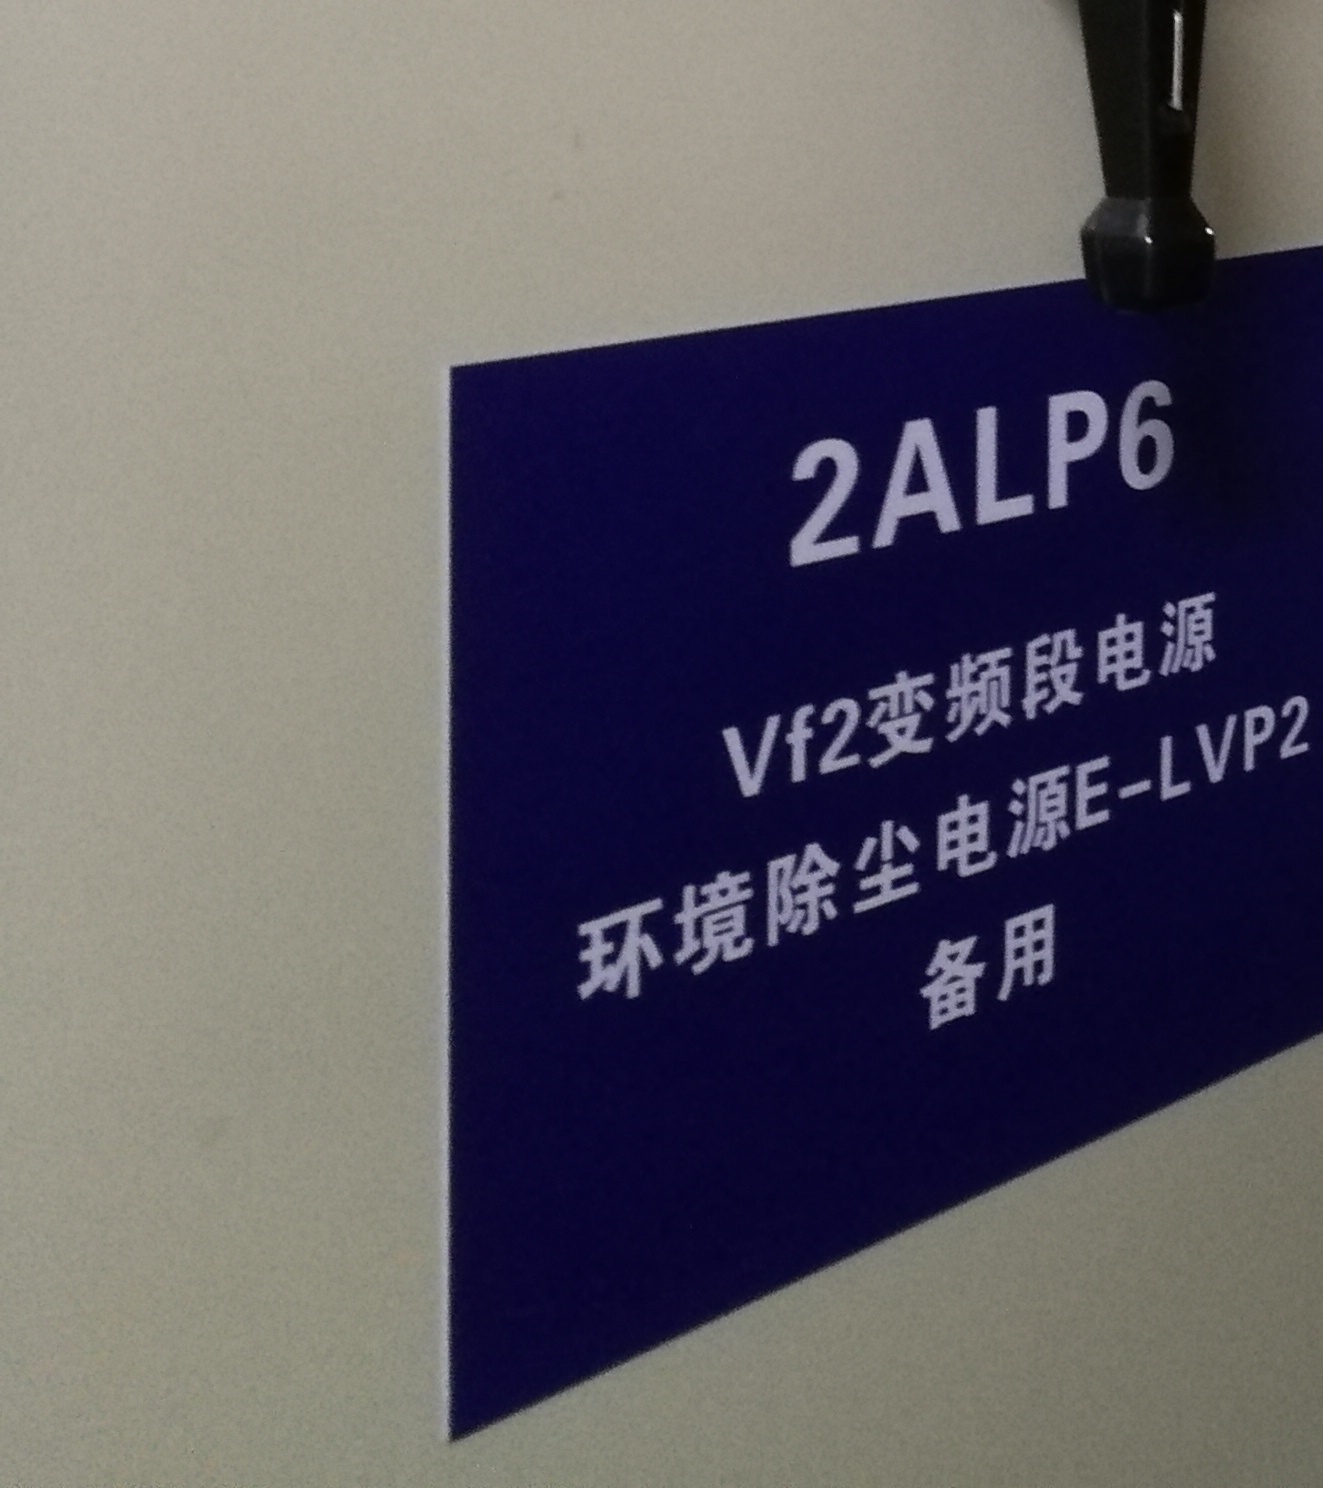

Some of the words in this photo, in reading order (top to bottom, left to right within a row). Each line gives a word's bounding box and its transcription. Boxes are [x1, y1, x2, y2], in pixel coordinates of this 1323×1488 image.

[791, 380, 1174, 567] 2ALP6
[722, 592, 1216, 799] Vf2变频段电源
[577, 695, 1311, 1000] 环境除尘电源E-LVP2
[920, 903, 1056, 1030] 备用
